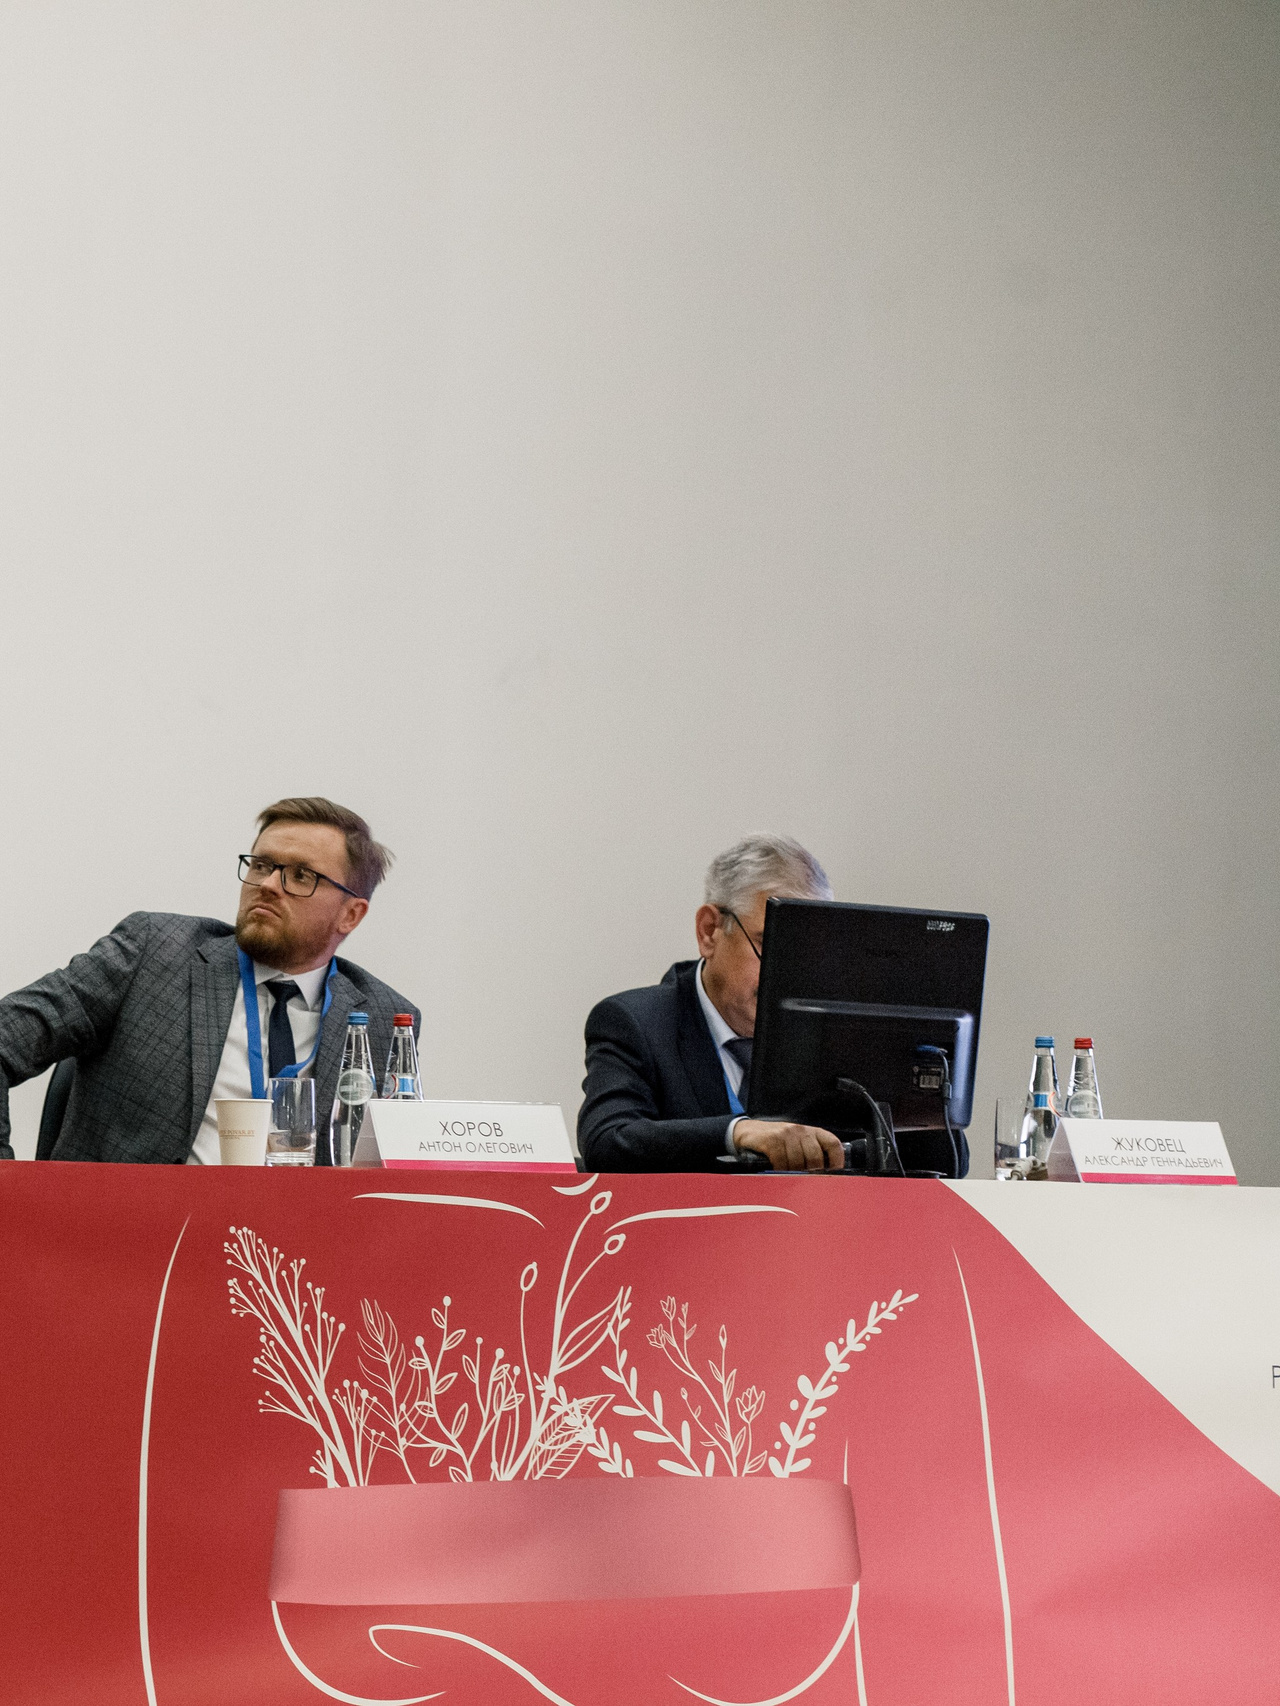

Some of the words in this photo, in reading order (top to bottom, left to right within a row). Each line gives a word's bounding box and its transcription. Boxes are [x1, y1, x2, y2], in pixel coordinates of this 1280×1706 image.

[438, 1120, 504, 1137] ХОРОВ
[418, 1141, 463, 1153] АНТОН
[465, 1141, 534, 1154] ОЛЕГОВИЧ
[1111, 1136, 1187, 1154] ЖУКОВЕЦ
[1084, 1155, 1149, 1167] АЛЕКСАНДР
[1151, 1156, 1224, 1169] ГЕННАДЬЕВИЧ
